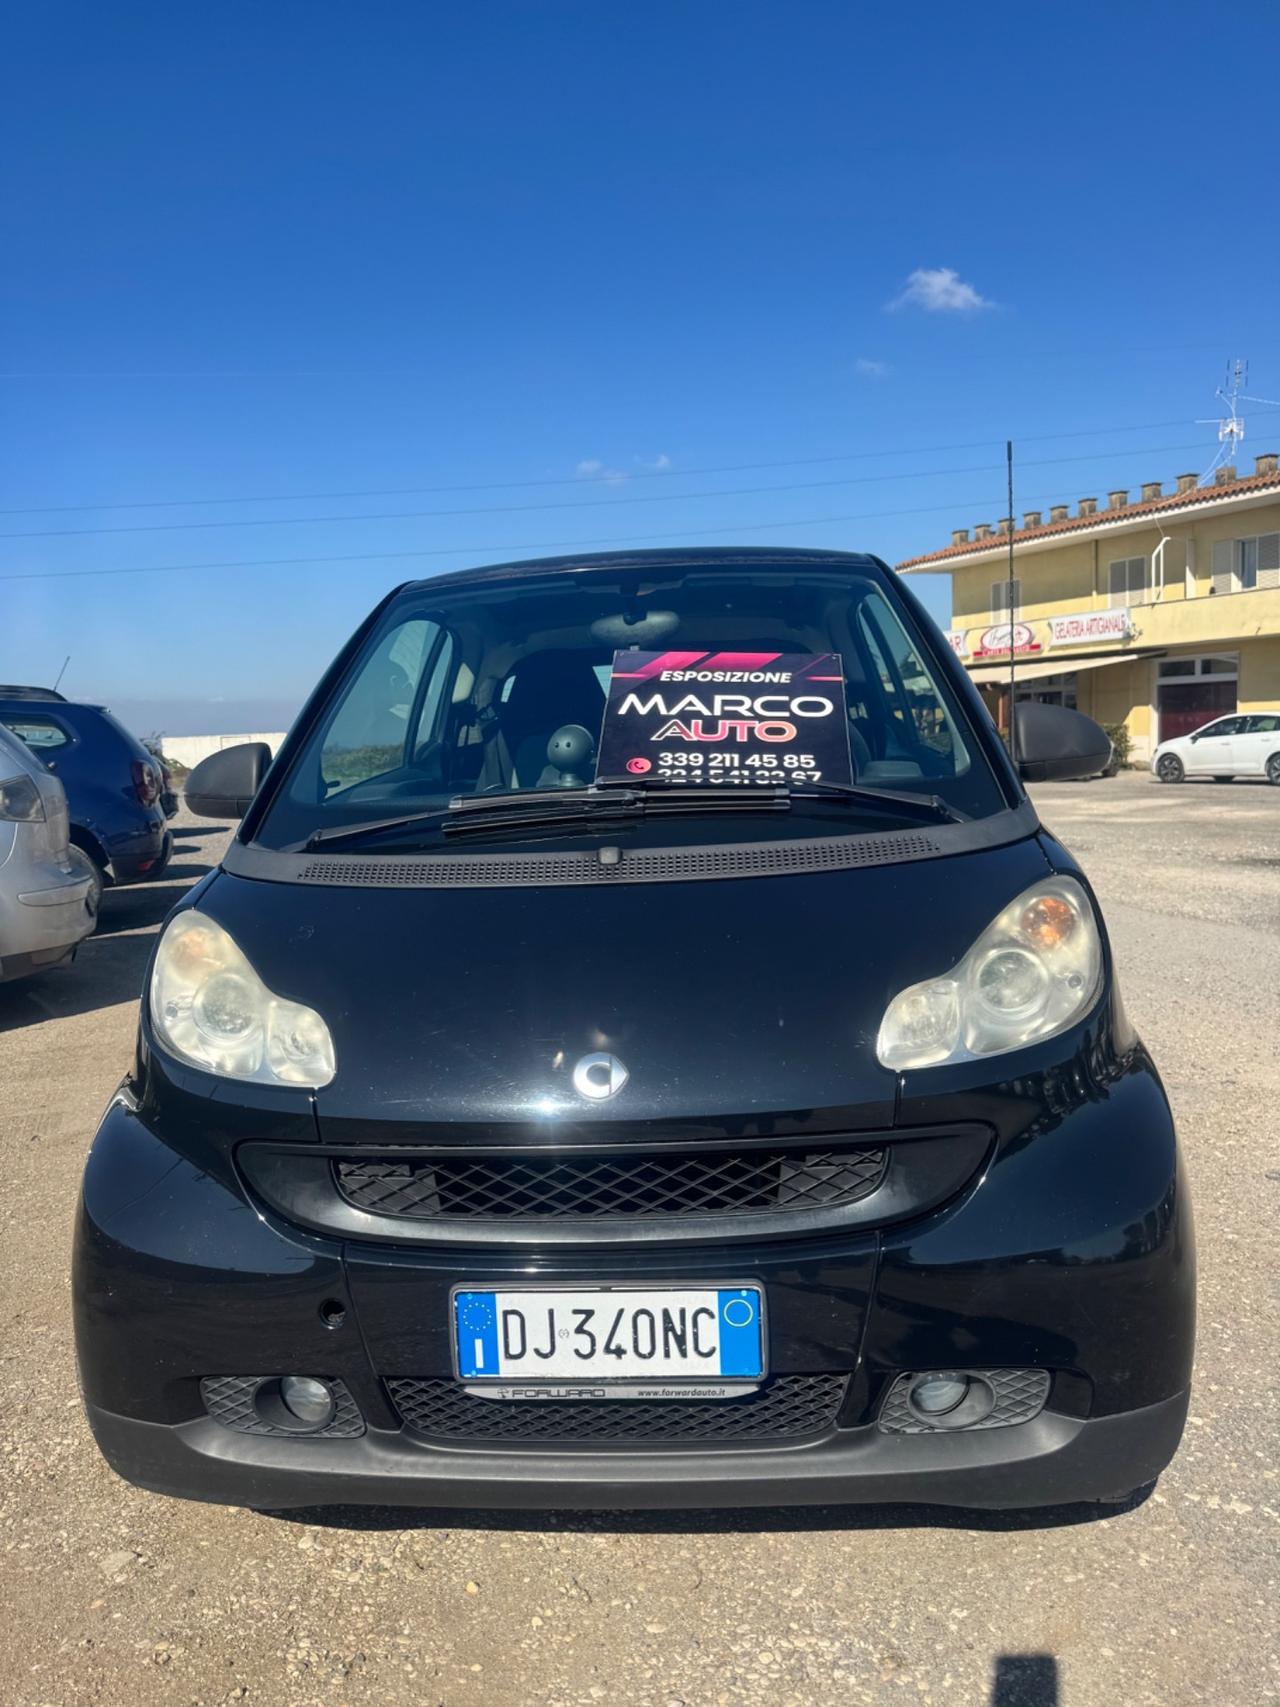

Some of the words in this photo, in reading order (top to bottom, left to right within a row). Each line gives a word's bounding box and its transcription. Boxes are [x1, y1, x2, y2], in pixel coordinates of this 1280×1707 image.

[659, 670, 793, 684] ESPOSIZIONE
[617, 693, 834, 718] MARCO
[650, 719, 798, 743] AUTO
[658, 752, 705, 767] 339
[708, 753, 740, 768] 211
[744, 754, 779, 768] 45
[782, 754, 817, 769] 85
[637, 1387, 726, 1398] www.forwardauto.it
